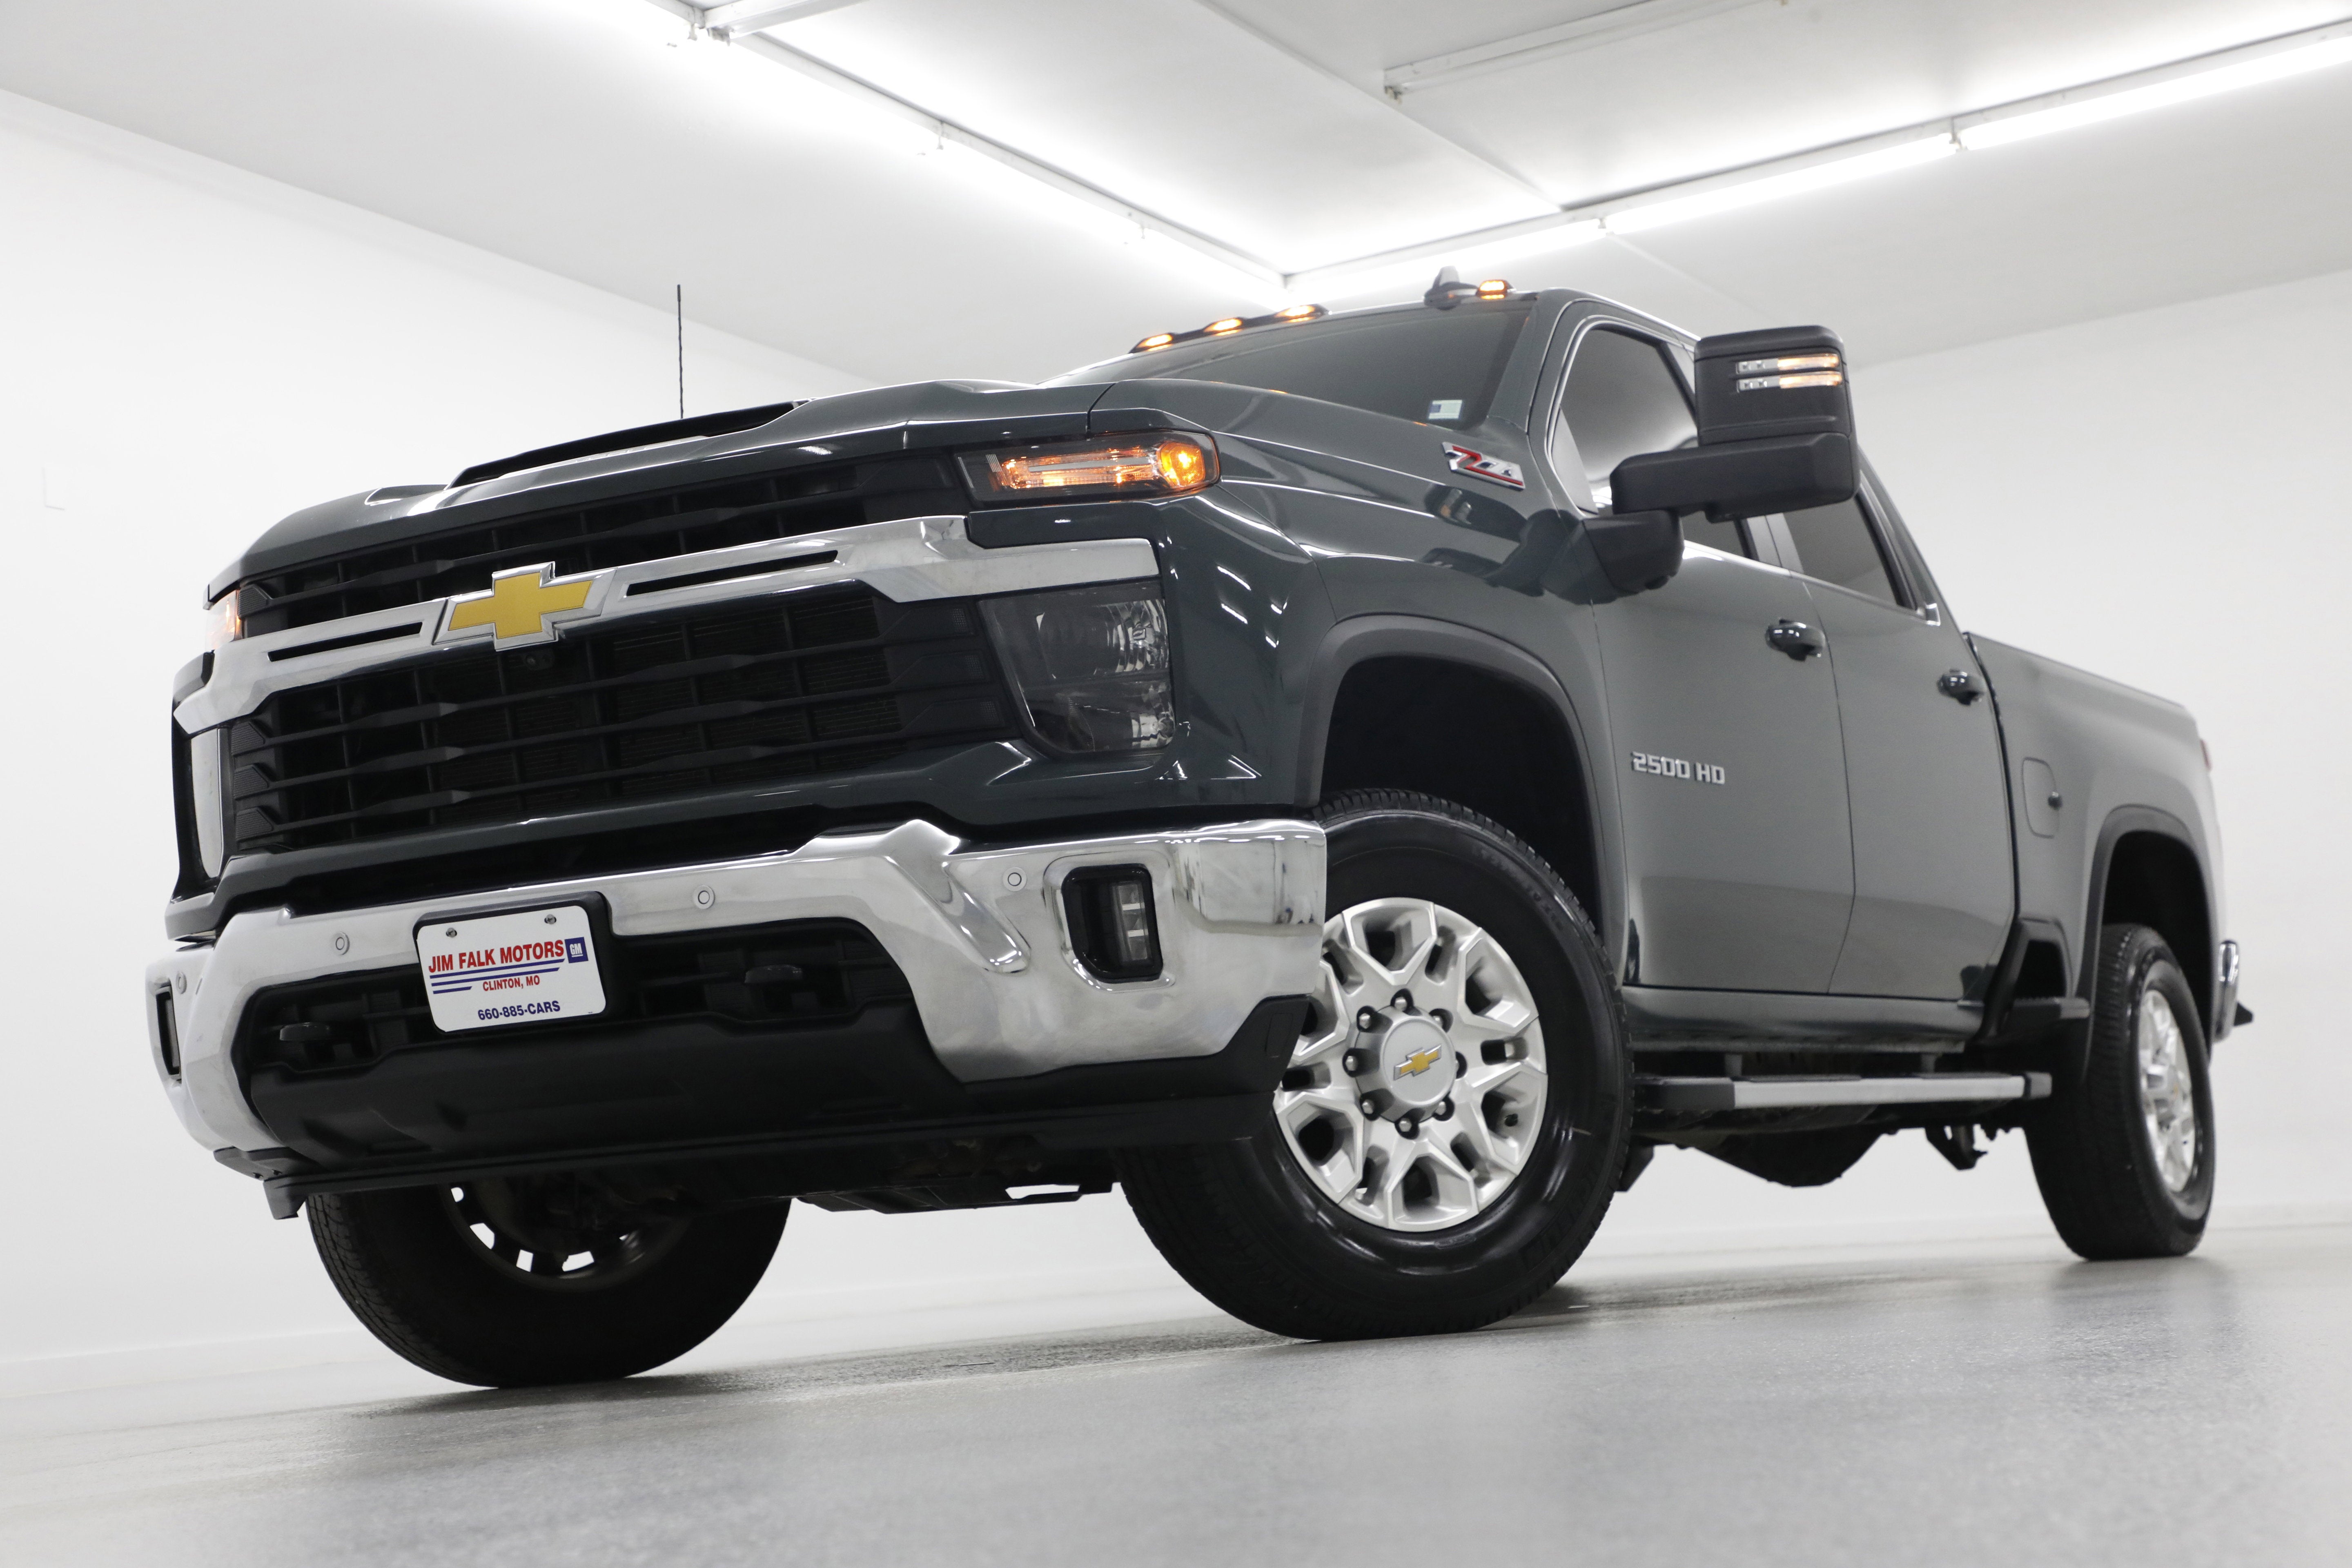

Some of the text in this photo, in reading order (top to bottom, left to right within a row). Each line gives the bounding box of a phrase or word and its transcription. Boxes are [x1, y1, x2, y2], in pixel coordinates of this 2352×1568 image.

[1442, 441, 1526, 490] Z71
[1632, 751, 1725, 784] 2500 HD
[428, 940, 564, 973] JIM FALK MOTORS
[569, 943, 583, 956] GM
[483, 975, 540, 991] CLINTON, MO
[478, 1000, 560, 1020] 660-885-CARS
